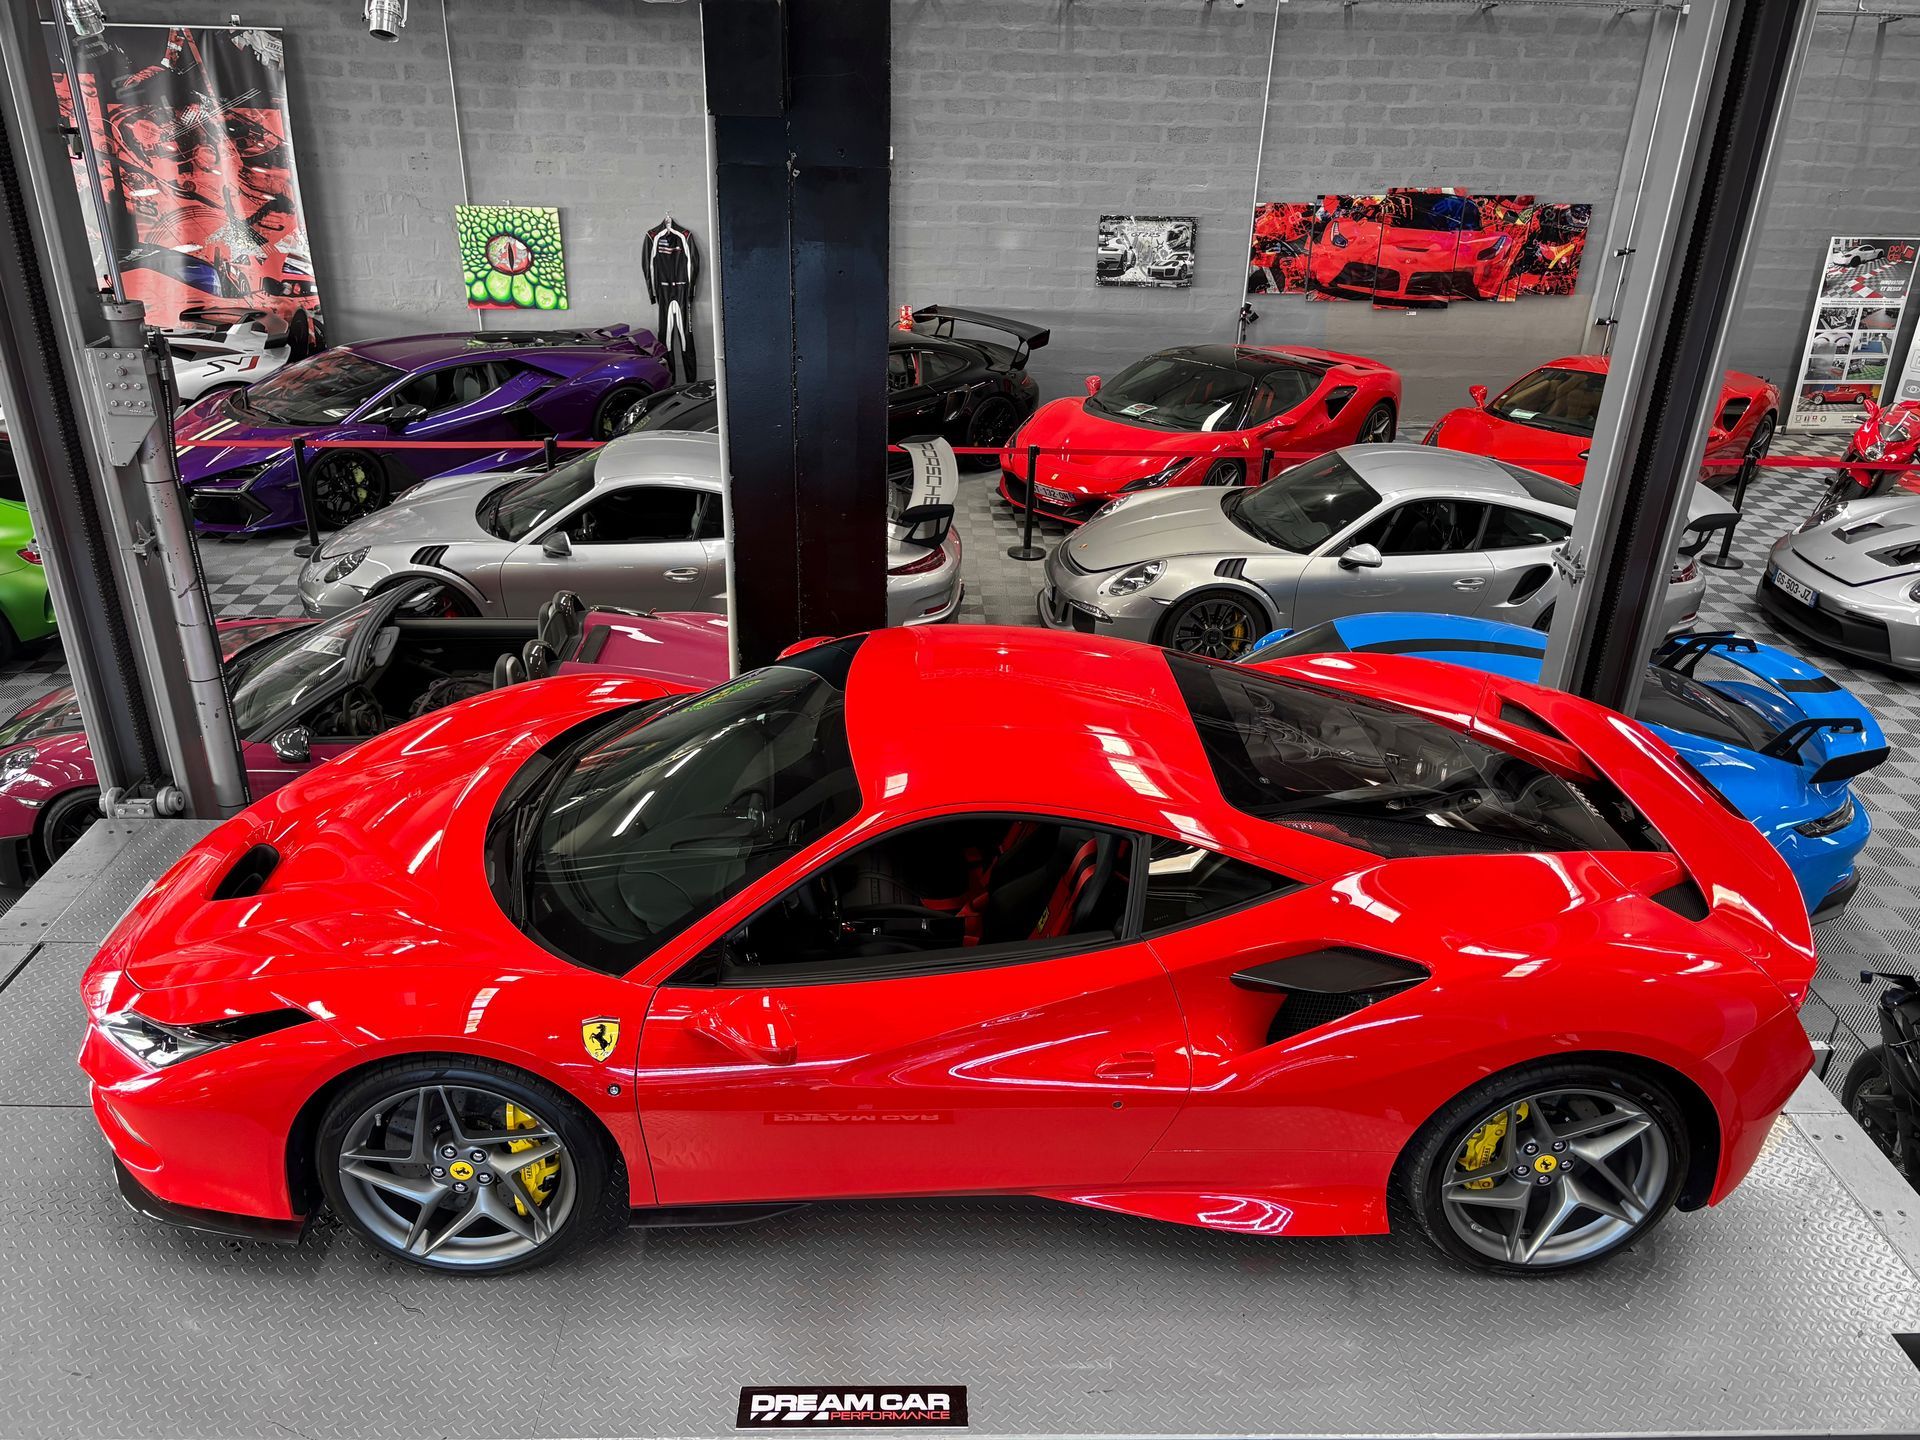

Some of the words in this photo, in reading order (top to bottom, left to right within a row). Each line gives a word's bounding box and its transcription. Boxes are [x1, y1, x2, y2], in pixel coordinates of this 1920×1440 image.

[919, 443, 942, 505] PORSCHE
[751, 1394, 875, 1411] DREAM
[880, 1393, 950, 1411] CAR
[830, 1411, 951, 1421] PERFORMANCE
